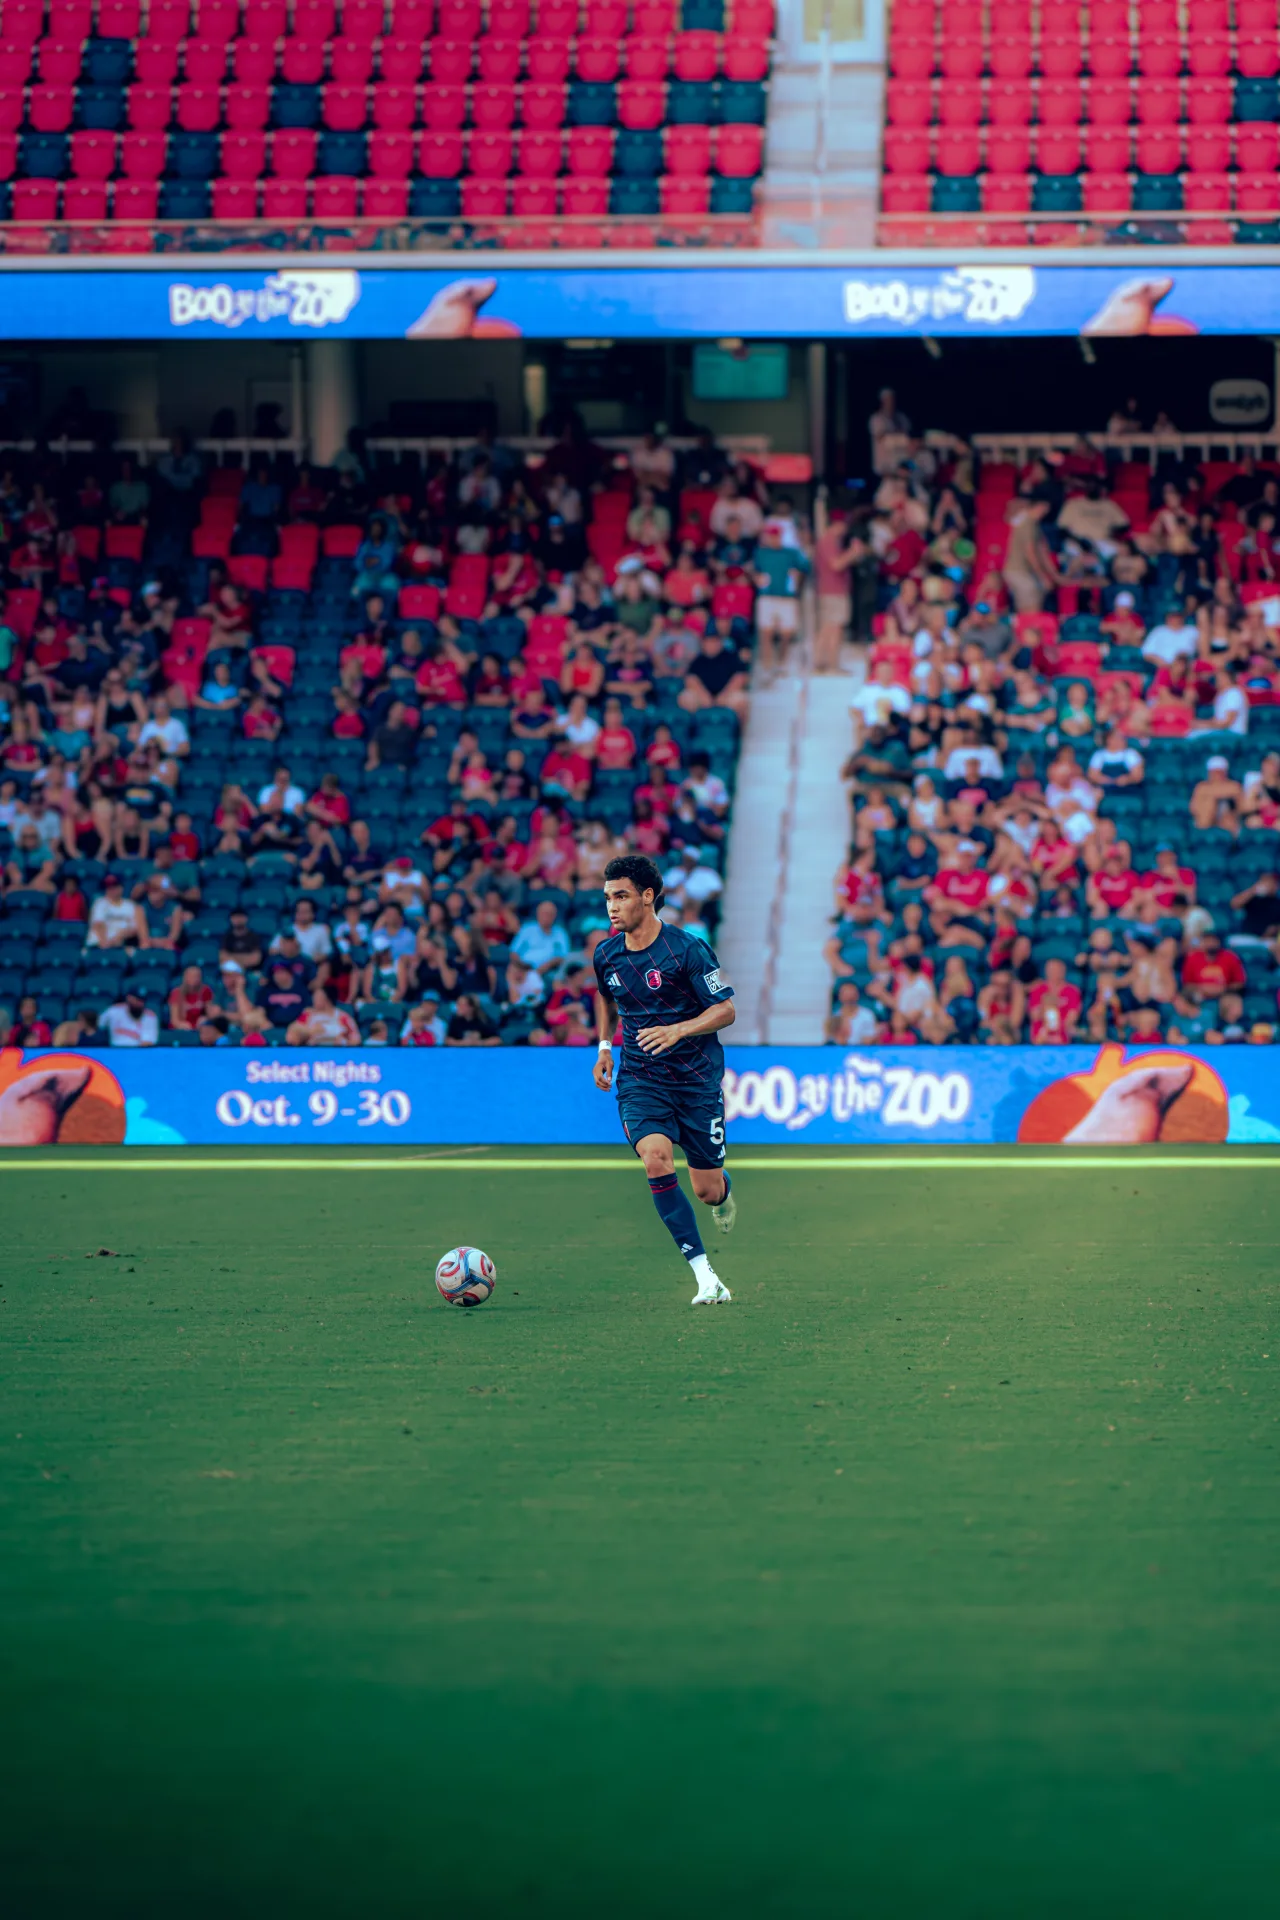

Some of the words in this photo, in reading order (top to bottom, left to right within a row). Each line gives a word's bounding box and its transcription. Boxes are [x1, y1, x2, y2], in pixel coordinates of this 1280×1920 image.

[246, 1060, 310, 1083] Select
[312, 1060, 381, 1088] Nights
[216, 1089, 301, 1127] Oct.
[831, 1068, 882, 1122] the
[710, 1117, 724, 1145] 5
